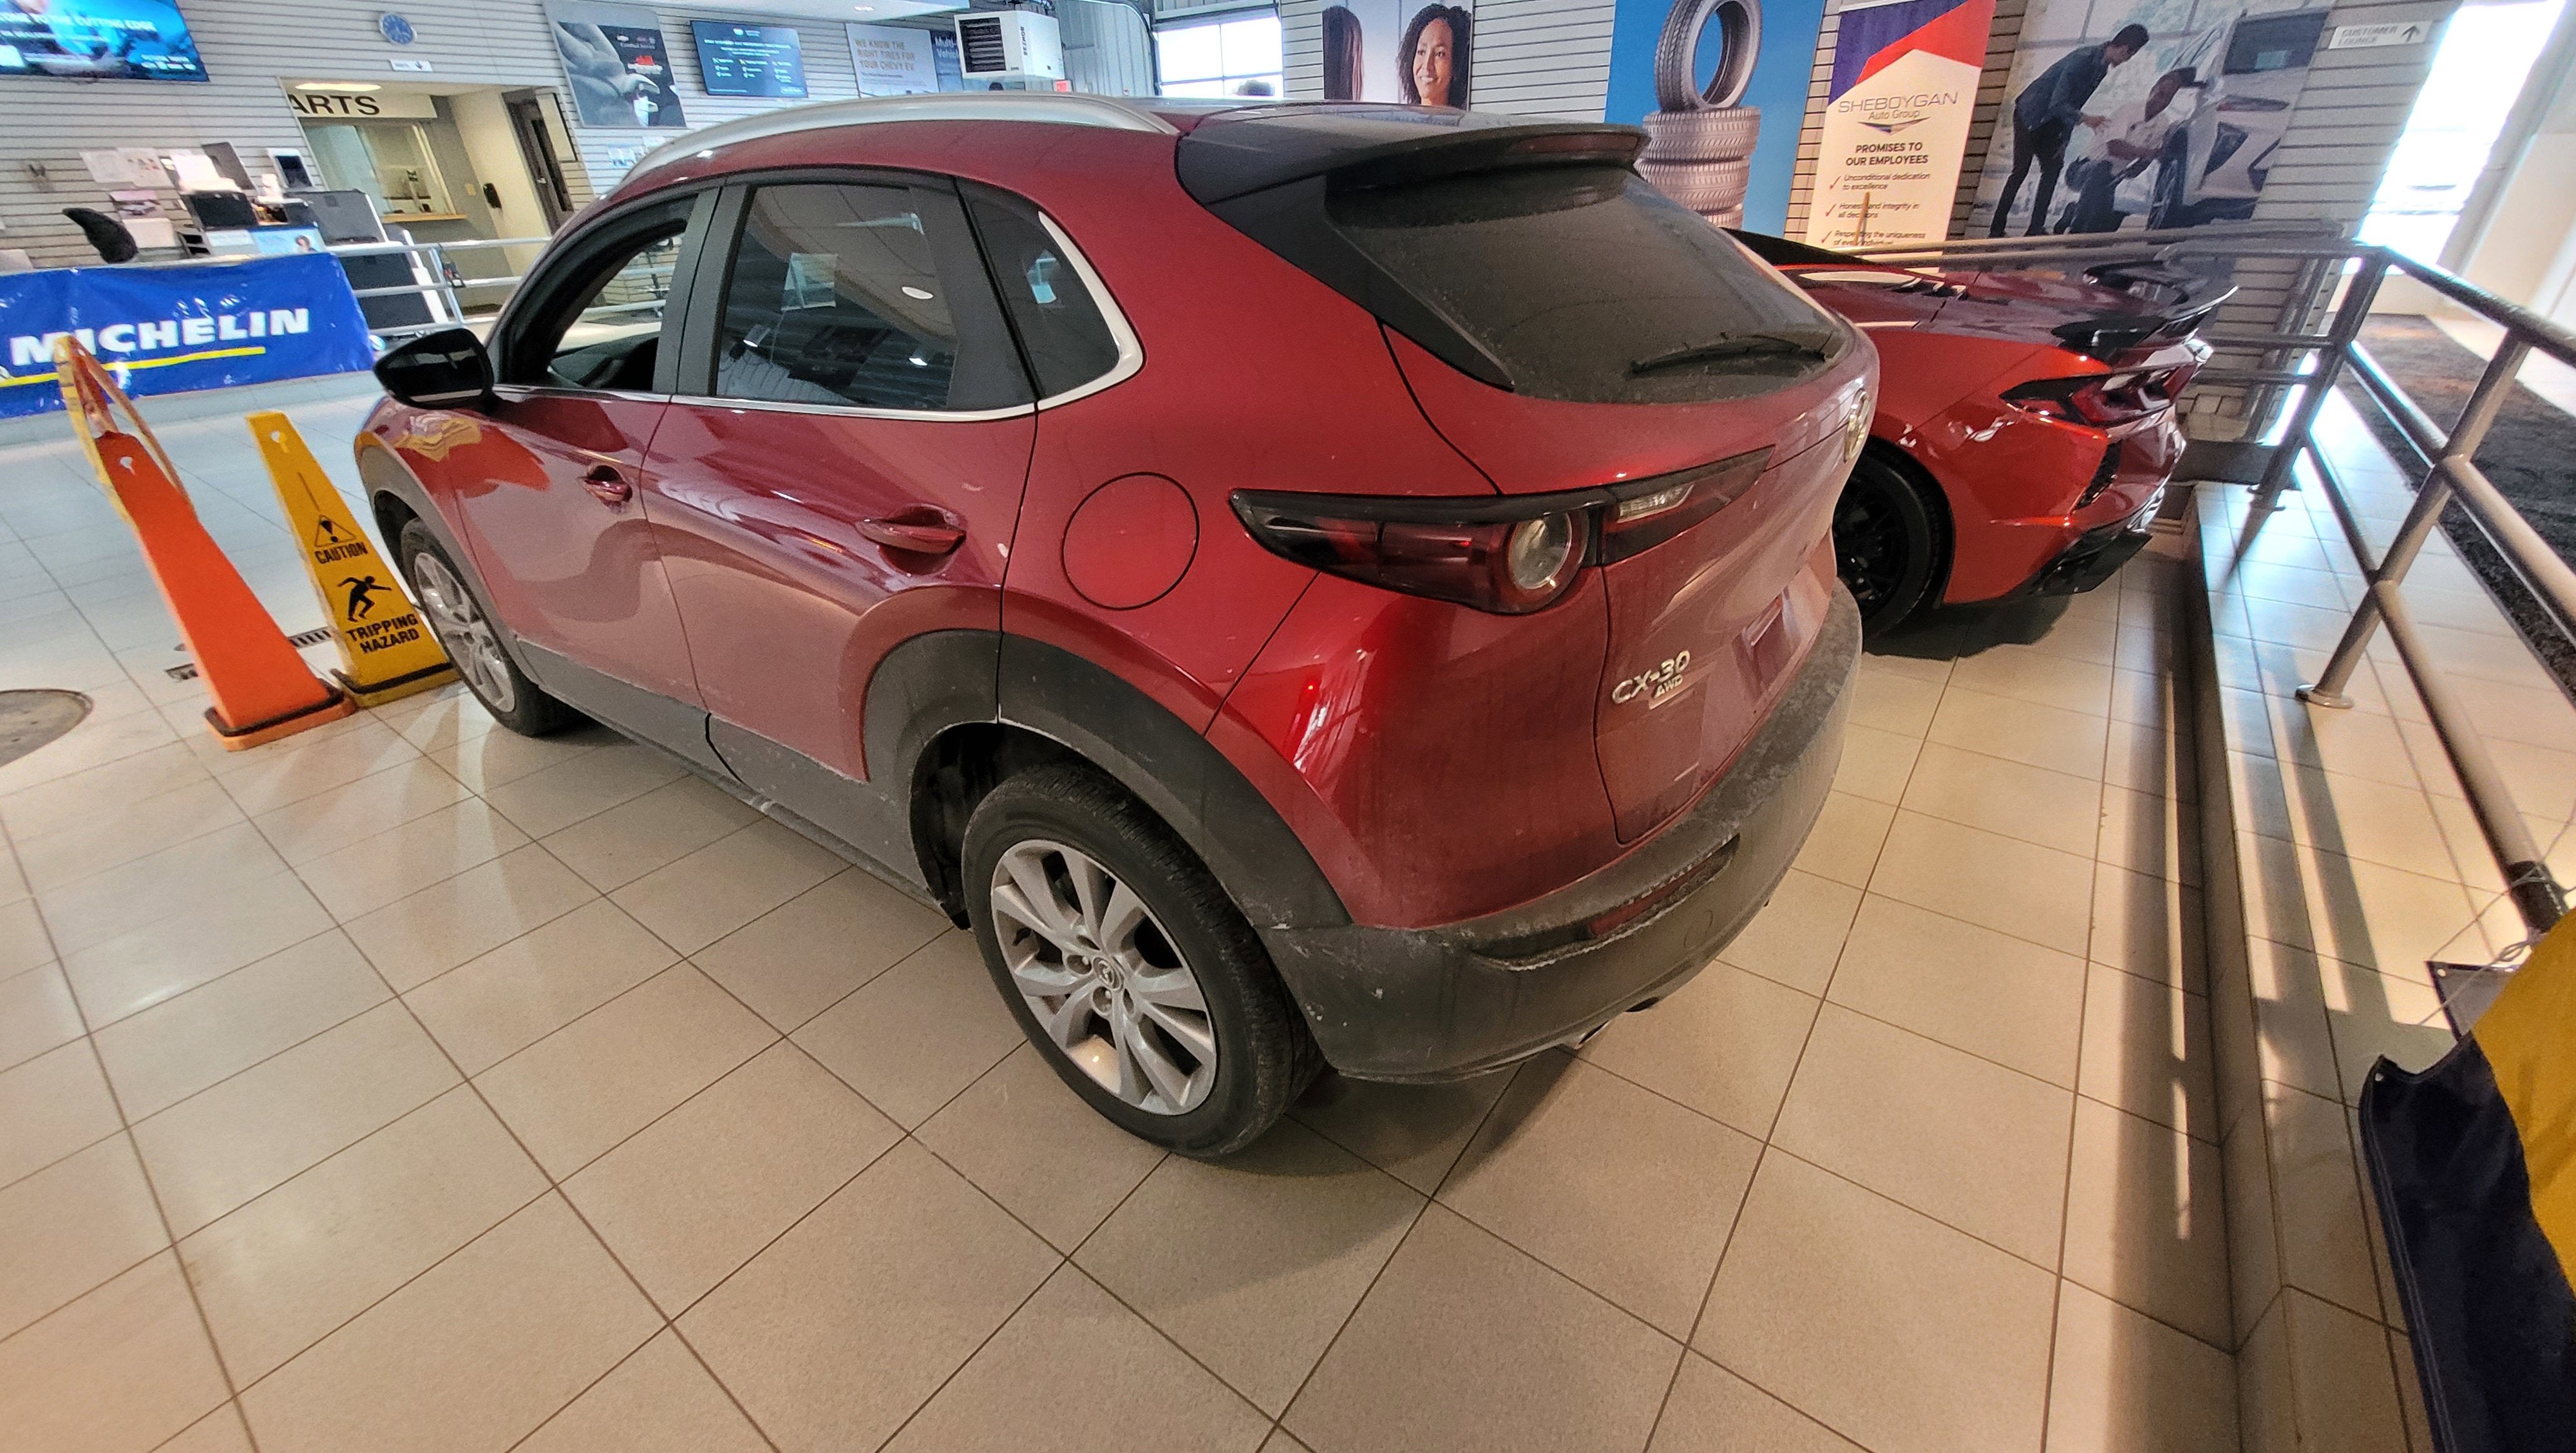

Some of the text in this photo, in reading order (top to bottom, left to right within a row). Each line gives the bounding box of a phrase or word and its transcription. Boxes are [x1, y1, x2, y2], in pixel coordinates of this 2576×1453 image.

[2342, 25, 2399, 37] CUSTOMER
[1838, 91, 1958, 113] SHEBOYGAN
[1868, 109, 1920, 120] Auto Group
[1855, 141, 1923, 154] PROMISES TO
[1845, 154, 1929, 166] OUR EMPLOYEES
[1844, 173, 1891, 181] Unconditional
[1851, 182, 1889, 191] excellence
[10, 307, 310, 367] MICHELIN
[314, 542, 368, 564] CAUTION
[346, 613, 419, 641] TRIPPING
[360, 629, 420, 654] HAZARD
[1612, 650, 1690, 704] CX-30
[1653, 674, 1683, 699] AWD
